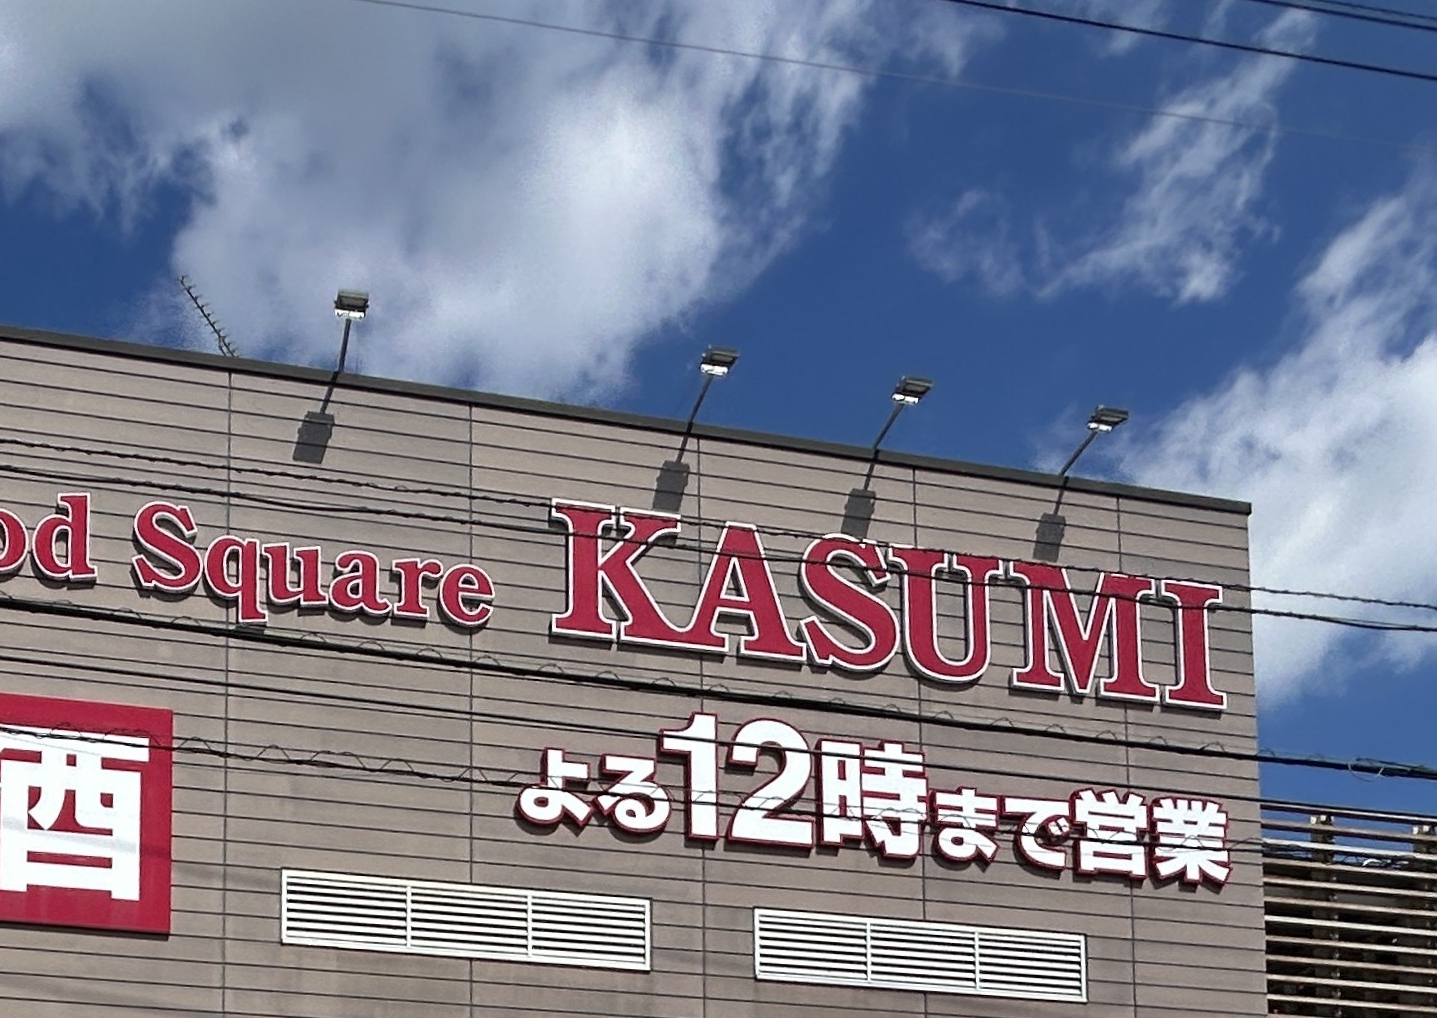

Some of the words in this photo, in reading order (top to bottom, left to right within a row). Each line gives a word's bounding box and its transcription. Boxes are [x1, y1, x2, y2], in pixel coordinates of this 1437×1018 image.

[131, 500, 496, 626] Square
[551, 497, 1228, 711] KASUMI
[515, 711, 1233, 886] よる12時まで営業
